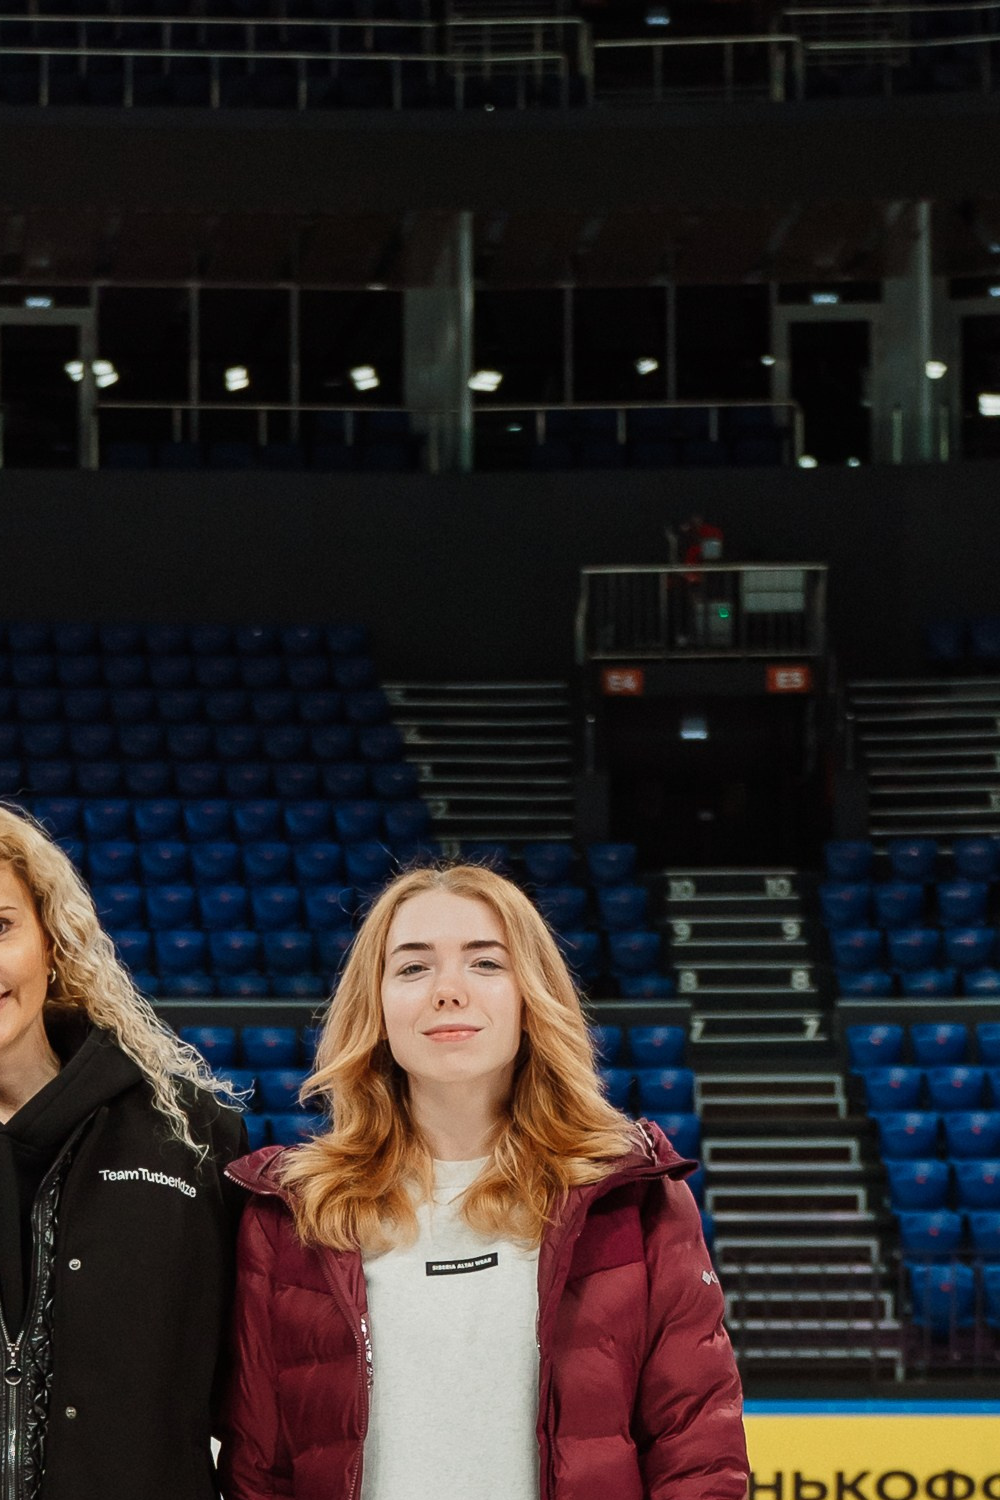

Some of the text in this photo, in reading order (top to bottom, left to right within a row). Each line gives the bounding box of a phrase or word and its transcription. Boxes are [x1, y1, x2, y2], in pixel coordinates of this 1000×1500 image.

[765, 878, 792, 897] 10
[672, 921, 691, 942] 9
[781, 920, 800, 941] 9
[791, 969, 810, 989] 8
[803, 1017, 820, 1039] 7
